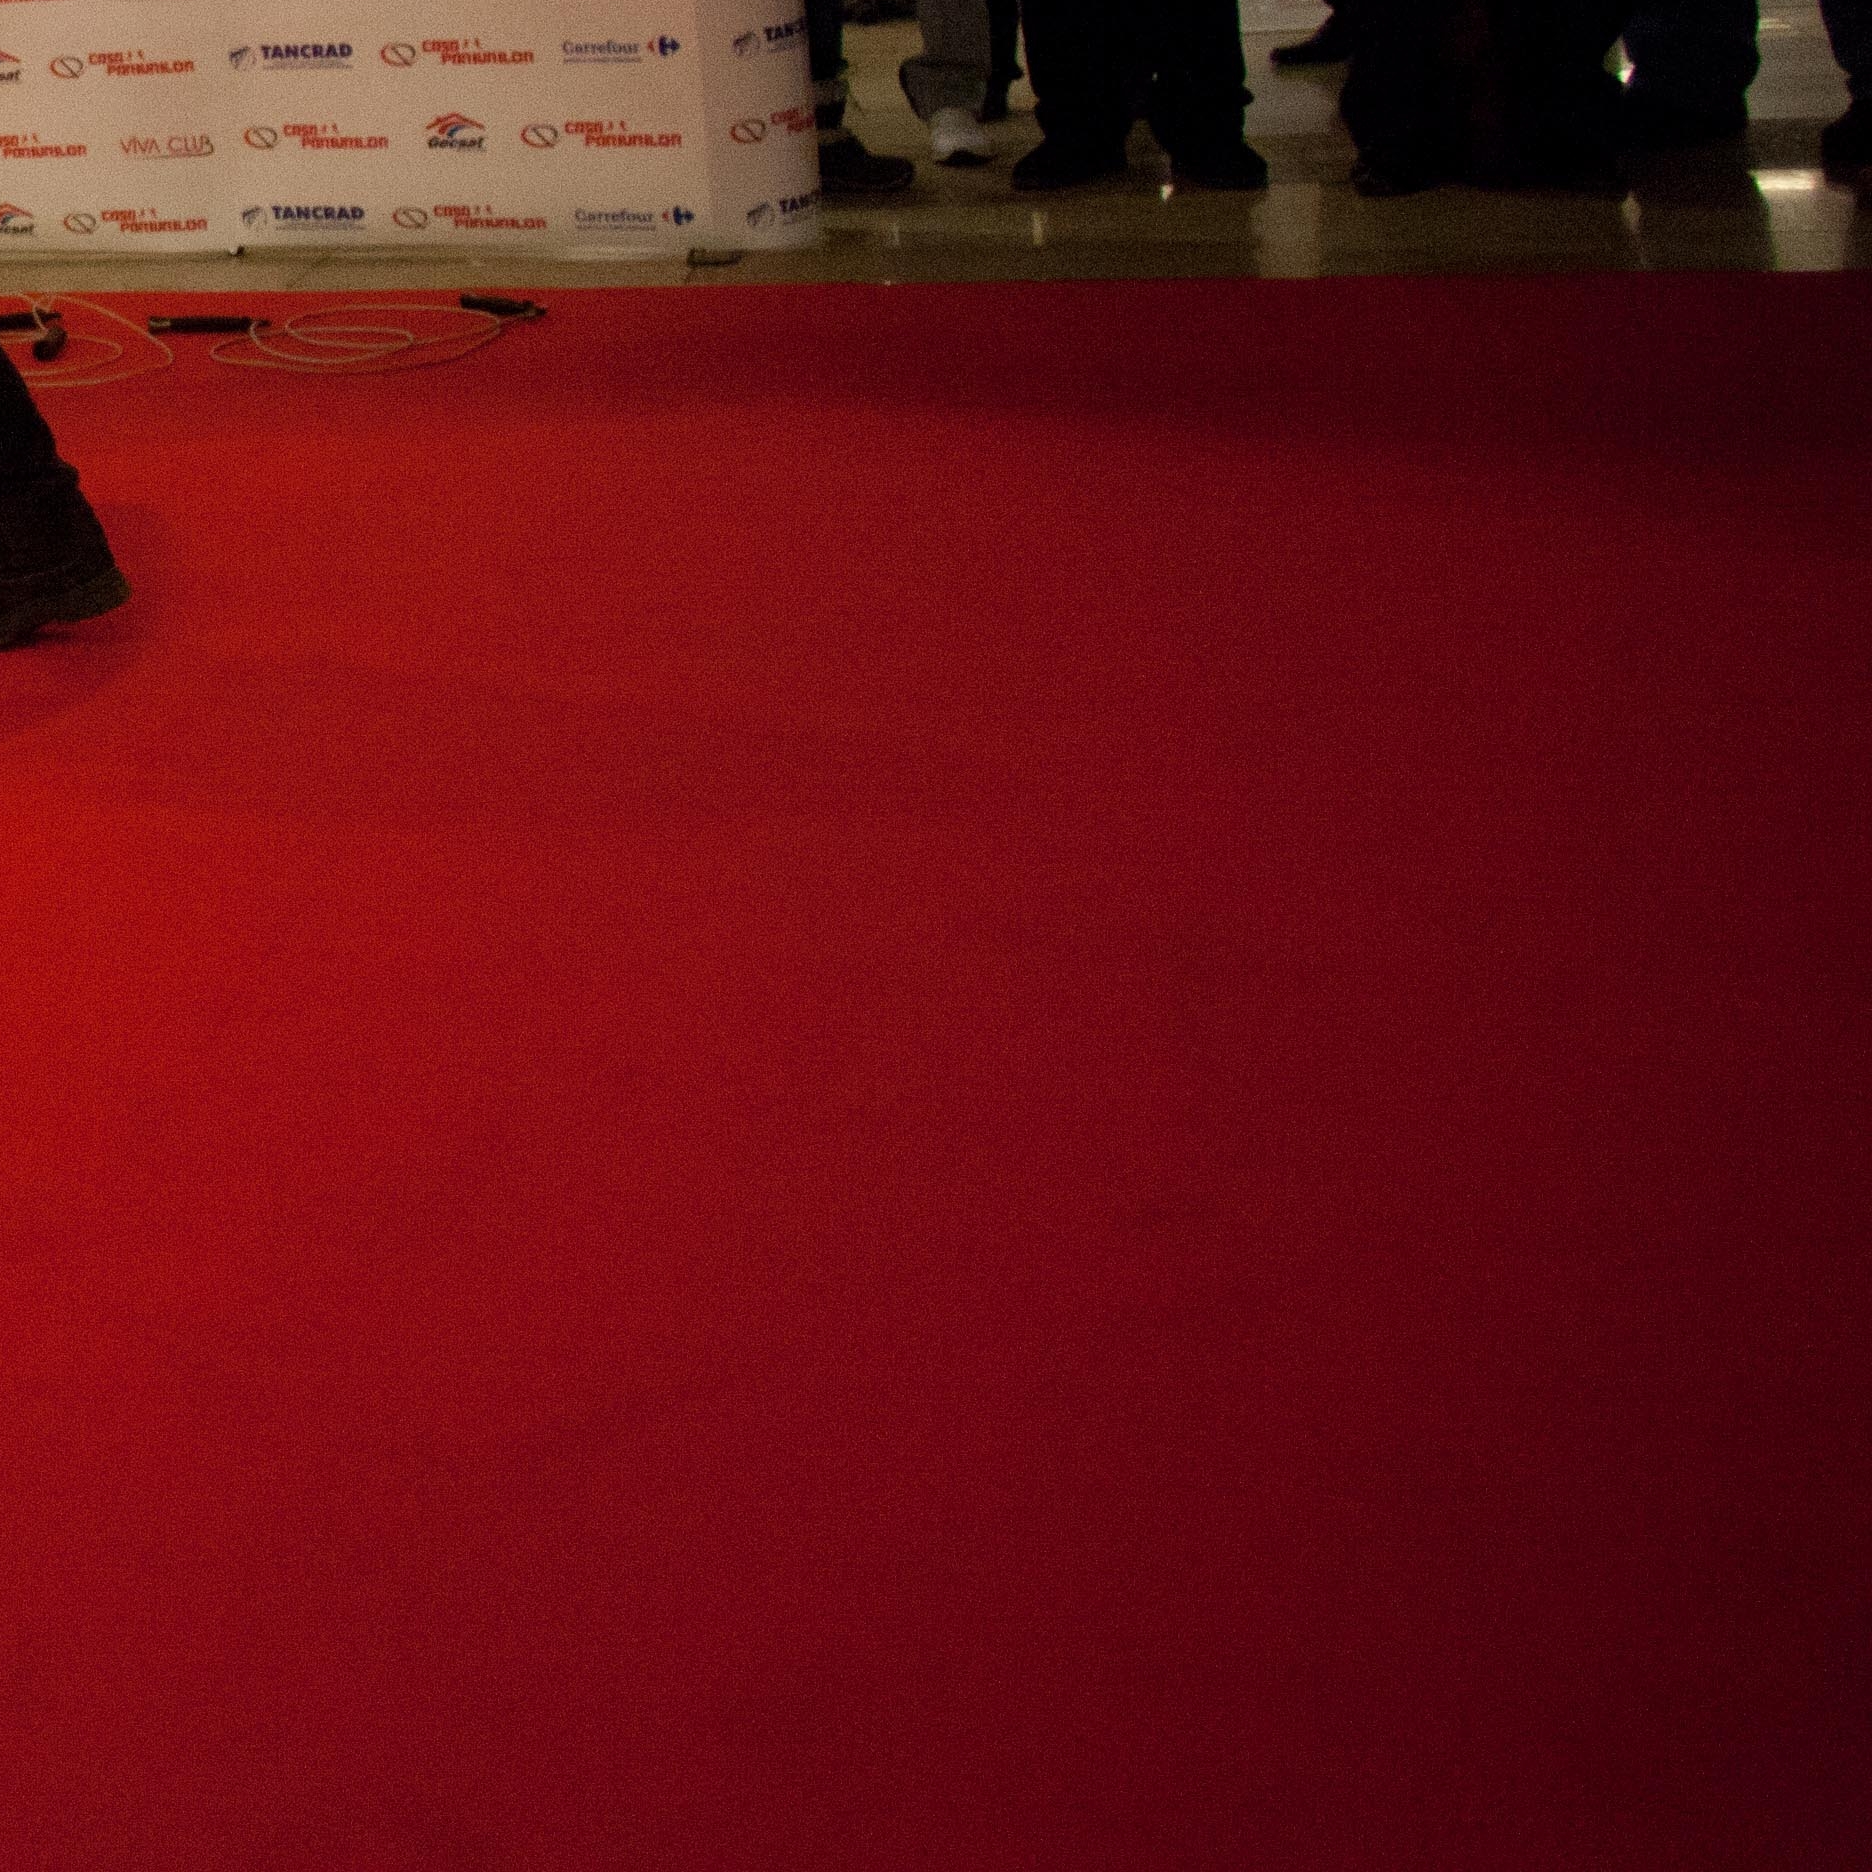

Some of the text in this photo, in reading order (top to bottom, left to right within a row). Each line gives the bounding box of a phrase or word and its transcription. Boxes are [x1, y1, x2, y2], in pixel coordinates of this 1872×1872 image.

[261, 44, 352, 59] TANCRAD
[562, 39, 639, 54] Carrefour
[167, 135, 214, 156] CLUB
[272, 206, 365, 221] TANCRAD
[576, 208, 653, 223] Carrefour
